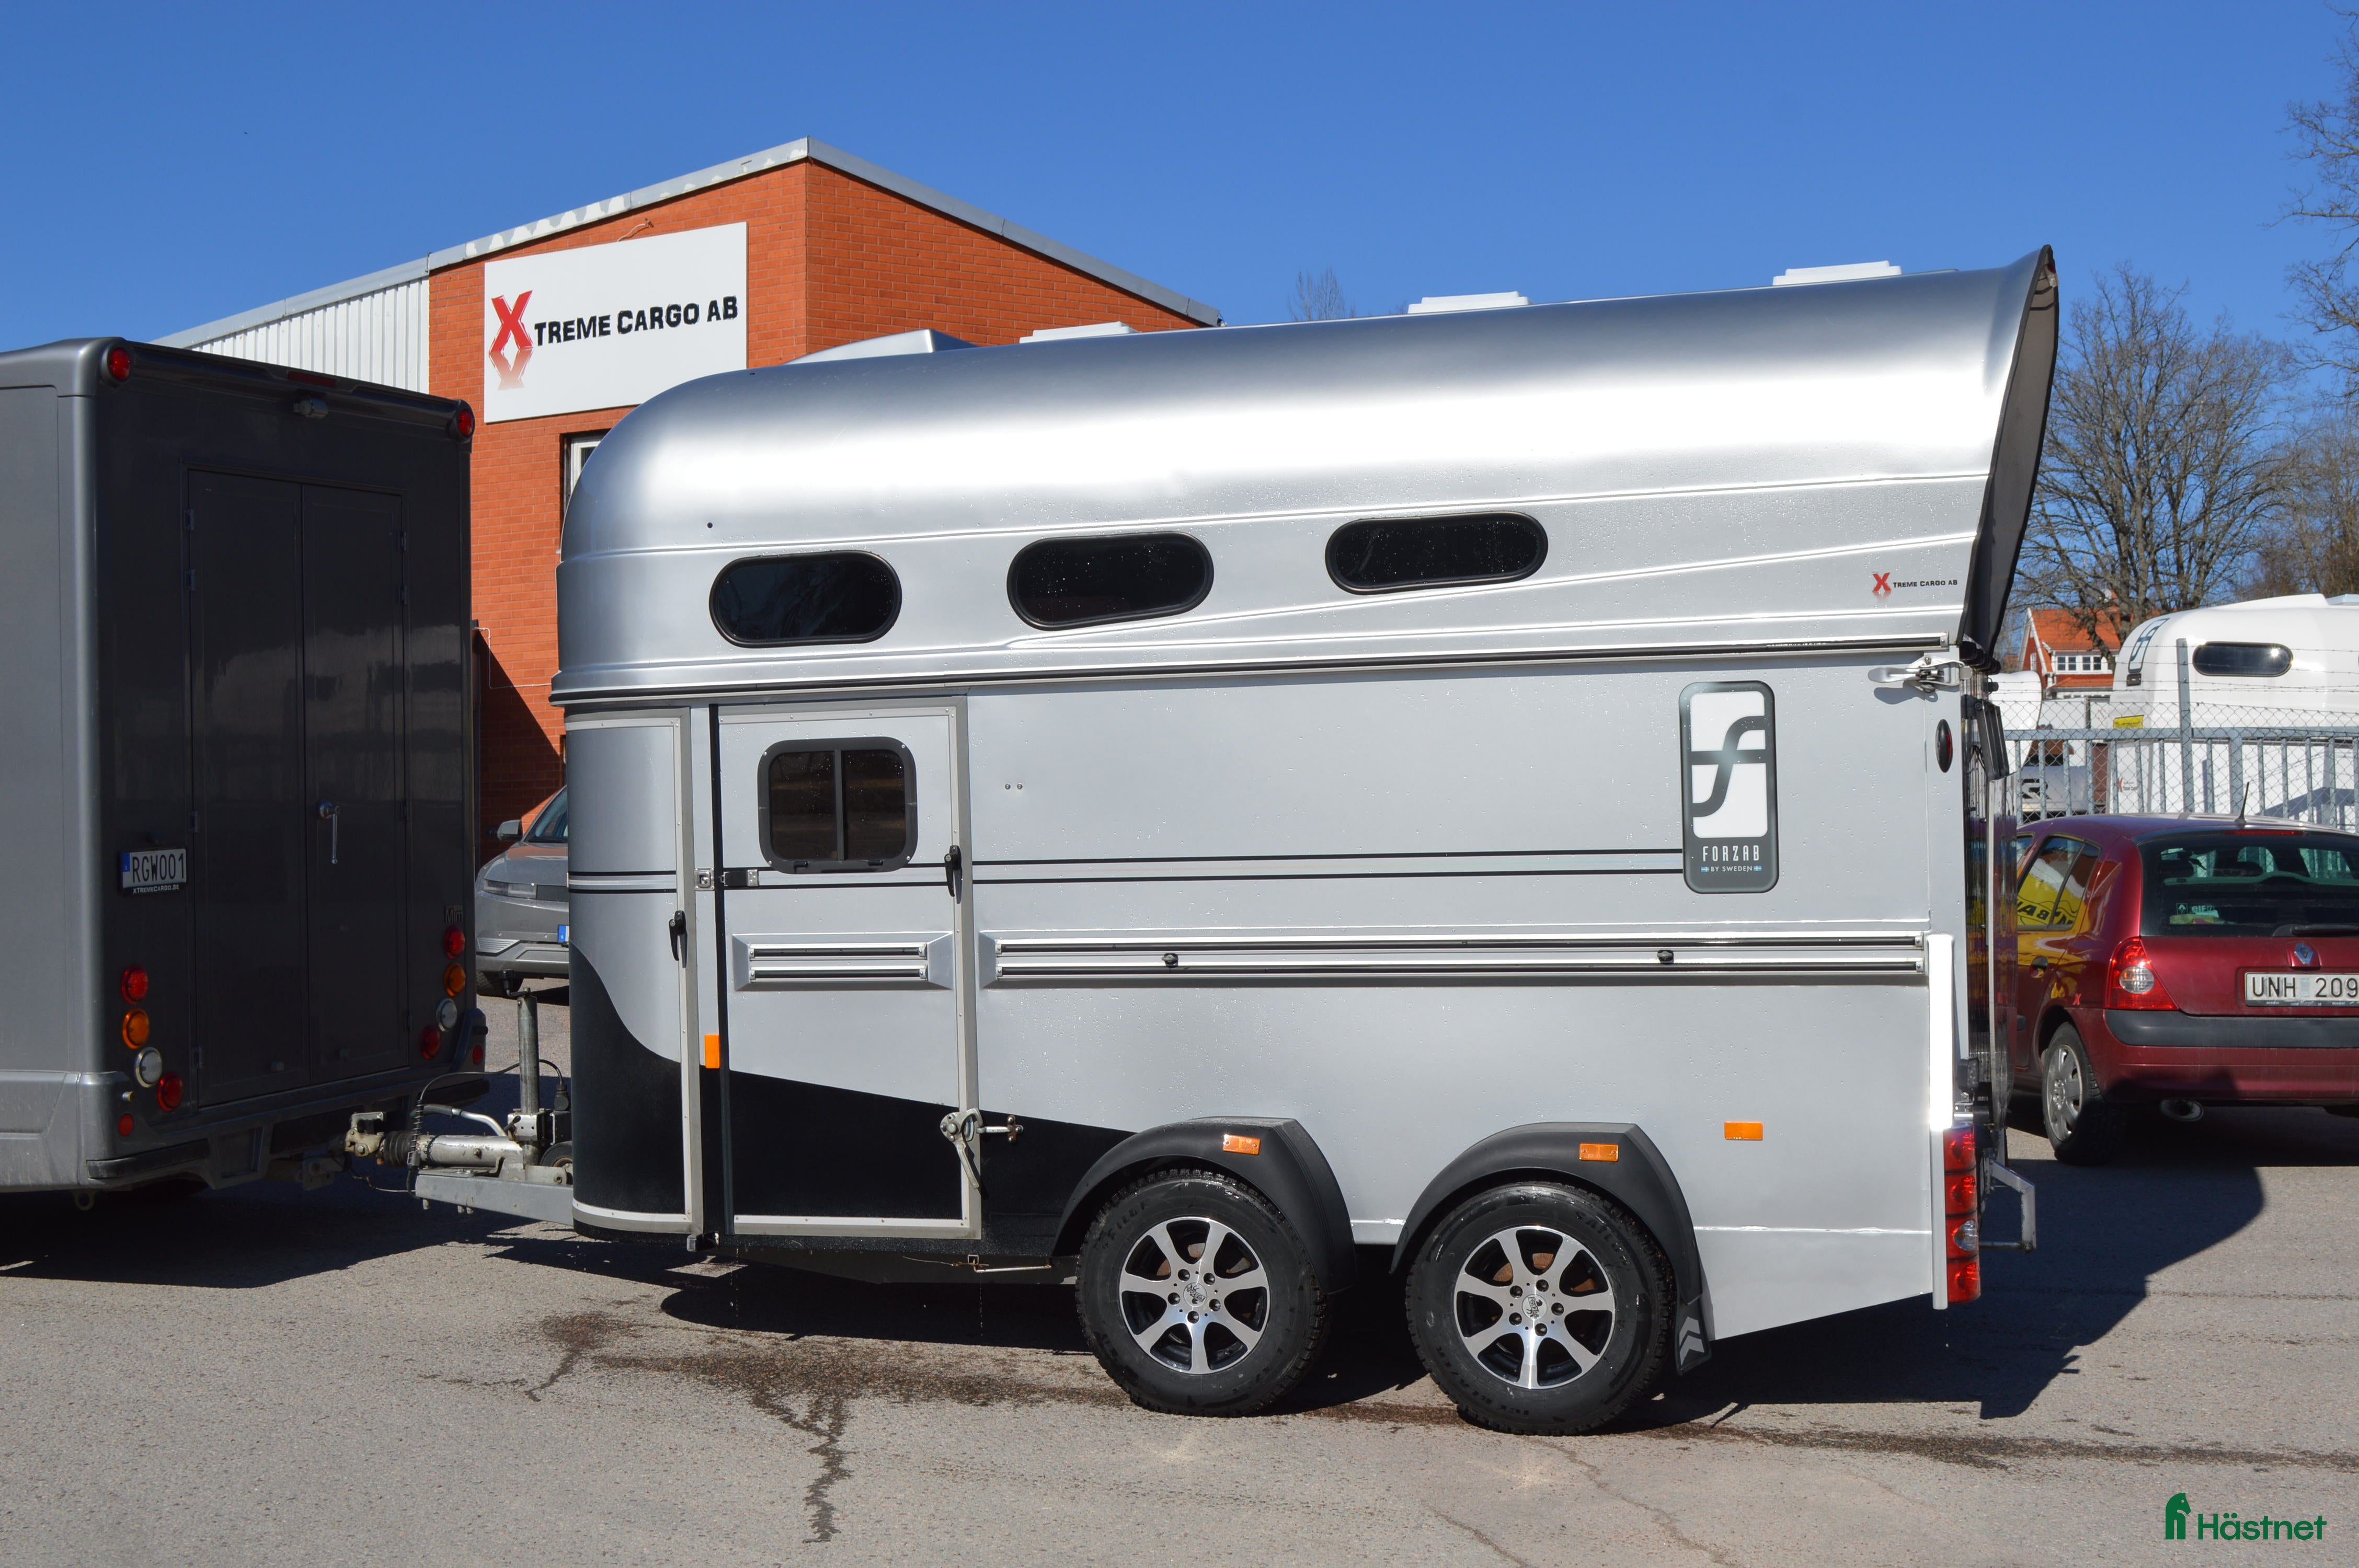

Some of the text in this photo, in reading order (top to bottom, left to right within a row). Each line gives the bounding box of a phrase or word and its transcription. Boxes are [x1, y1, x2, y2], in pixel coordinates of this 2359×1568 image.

[617, 303, 700, 335] CARGO
[706, 295, 738, 322] AB
[1702, 845, 1759, 862] FORZAB
[132, 852, 185, 883] RGW001
[133, 884, 179, 894] XTREMECARGO.SE
[2252, 976, 2358, 998] UNH 209
